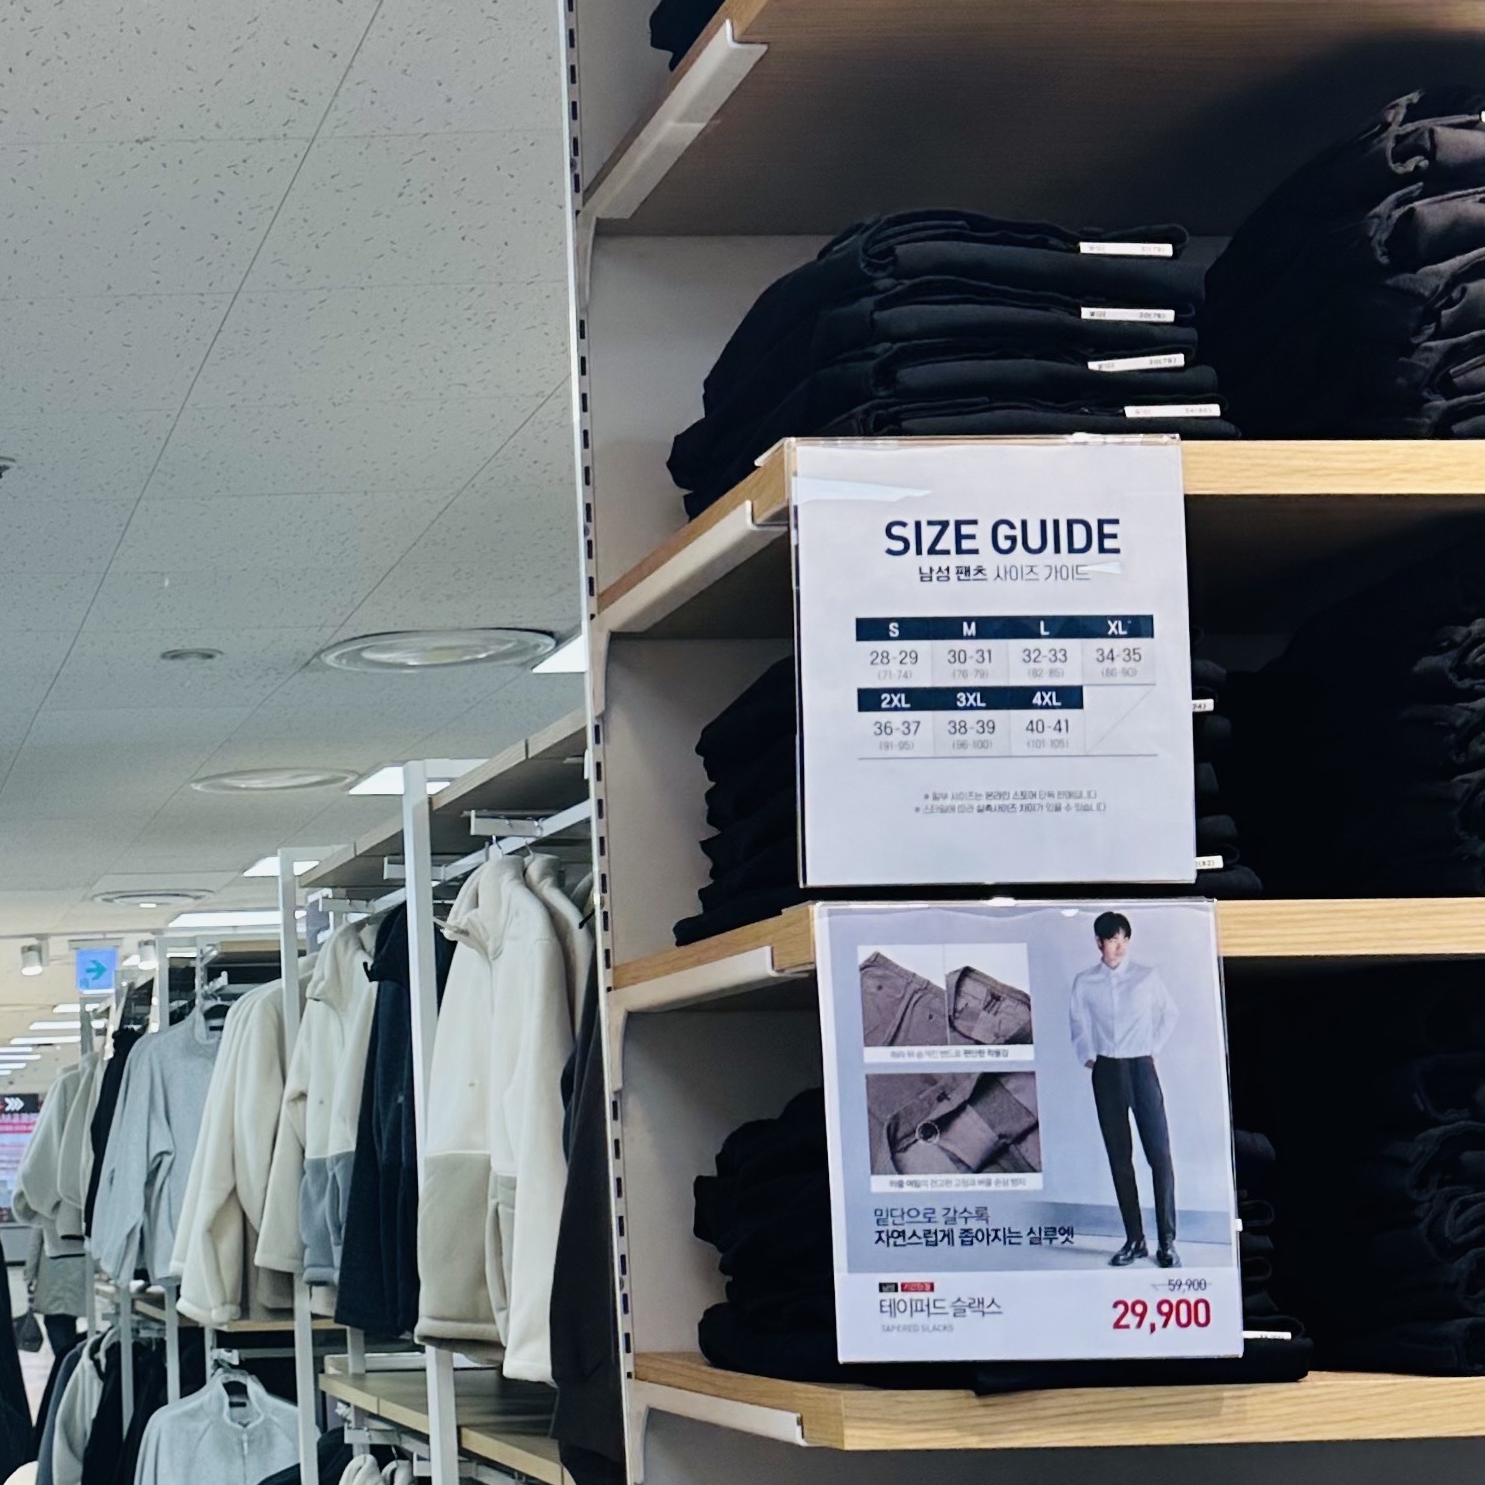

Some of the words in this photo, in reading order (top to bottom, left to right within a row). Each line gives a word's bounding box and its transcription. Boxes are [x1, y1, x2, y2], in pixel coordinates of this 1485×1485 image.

[884, 519, 980, 556] SIZE
[991, 518, 1121, 555] GUIDE
[918, 565, 951, 583] 남성
[954, 564, 988, 582] 팬츠
[994, 564, 1040, 582] 사이즈
[1044, 564, 1092, 582] 가이드
[888, 622, 899, 637] S
[963, 622, 976, 636] M
[1040, 621, 1050, 636] L
[1108, 620, 1127, 635] XL
[870, 650, 918, 665] 28-29
[948, 650, 992, 664] 30-31
[1022, 648, 1068, 663] 32-33
[1096, 648, 1142, 662] 34-35
[881, 693, 910, 708] 2XL
[956, 692, 986, 708] 3XL
[1032, 692, 1062, 706] 4XL
[874, 721, 920, 736] 36-37
[948, 720, 996, 735] 38-39
[1026, 719, 1069, 734] 40-41
[874, 1207, 938, 1226] 밑단으로
[942, 1206, 990, 1226] 갈수록
[874, 1228, 955, 1248] 자연스럽게
[958, 1226, 1023, 1246] 좁아지는
[1027, 1226, 1074, 1246] 실루엣
[1168, 1278, 1207, 1294] 59,900
[879, 1298, 948, 1318] 테이퍼드
[950, 1297, 1003, 1318] 슬랙스
[1112, 1298, 1211, 1334] 29,900
